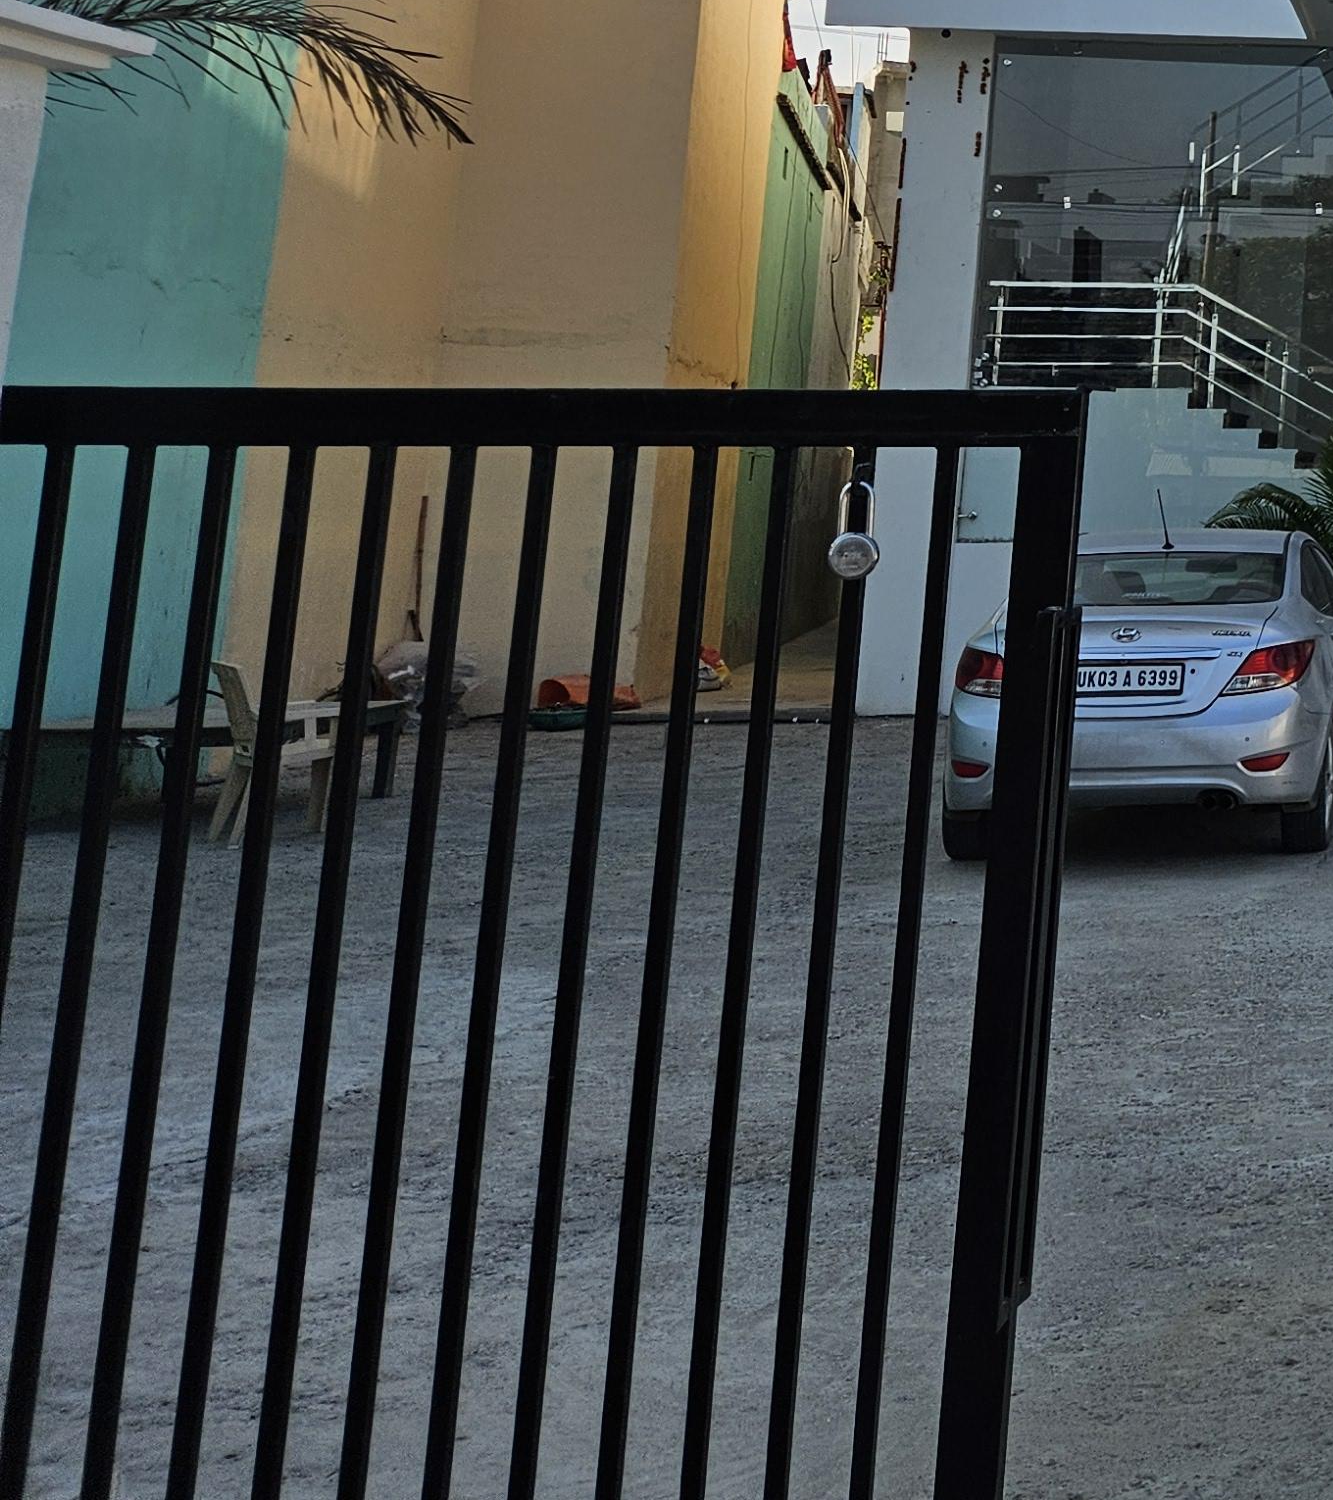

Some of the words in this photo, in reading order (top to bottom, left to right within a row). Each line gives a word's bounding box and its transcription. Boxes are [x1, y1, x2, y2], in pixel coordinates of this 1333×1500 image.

[1077, 670, 1117, 688] UK03
[1122, 670, 1132, 687] A
[1137, 669, 1178, 687] 6399
